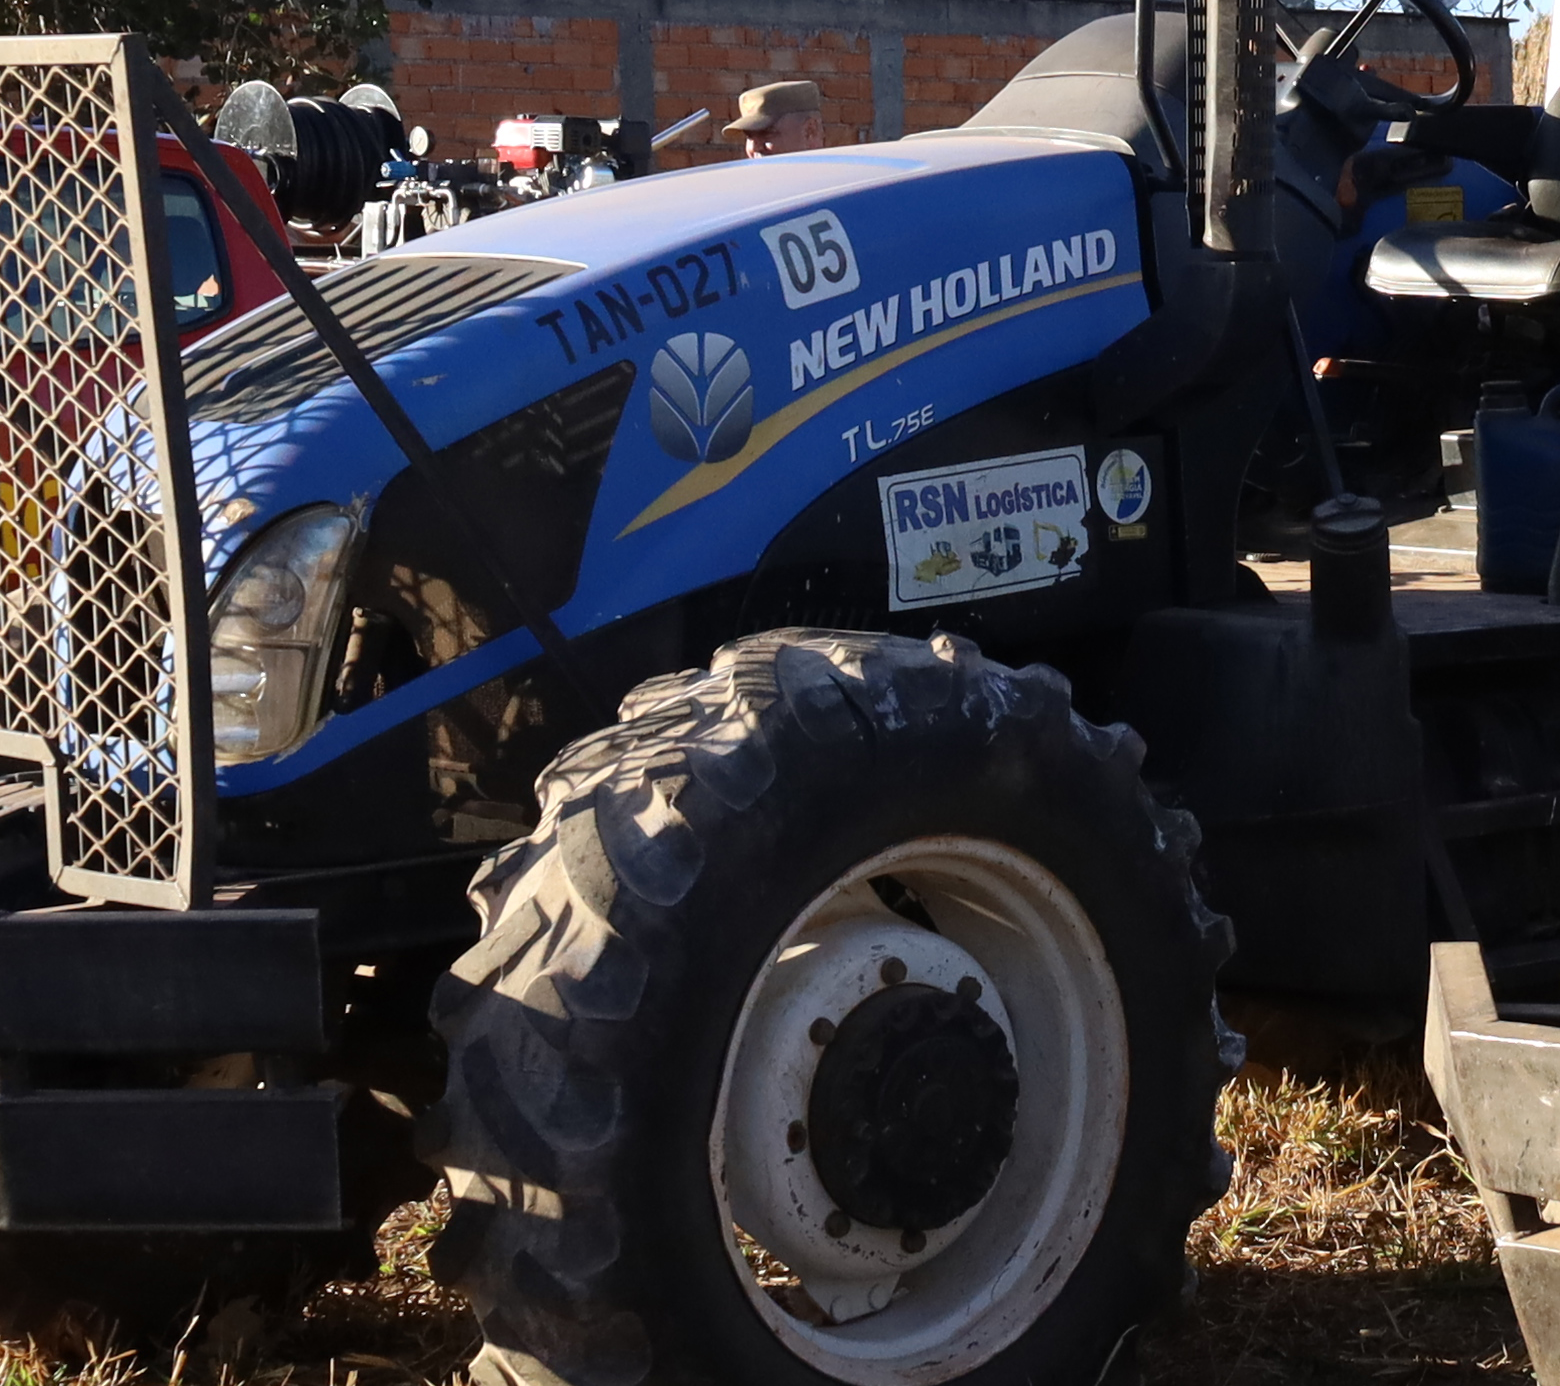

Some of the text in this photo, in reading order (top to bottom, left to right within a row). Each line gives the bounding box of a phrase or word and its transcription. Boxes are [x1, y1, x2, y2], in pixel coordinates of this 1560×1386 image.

[778, 220, 847, 294] 05
[790, 228, 1117, 391] NEW HOLLAND
[894, 481, 970, 533] RSN
[974, 479, 1079, 520] LOGÍSTICA
